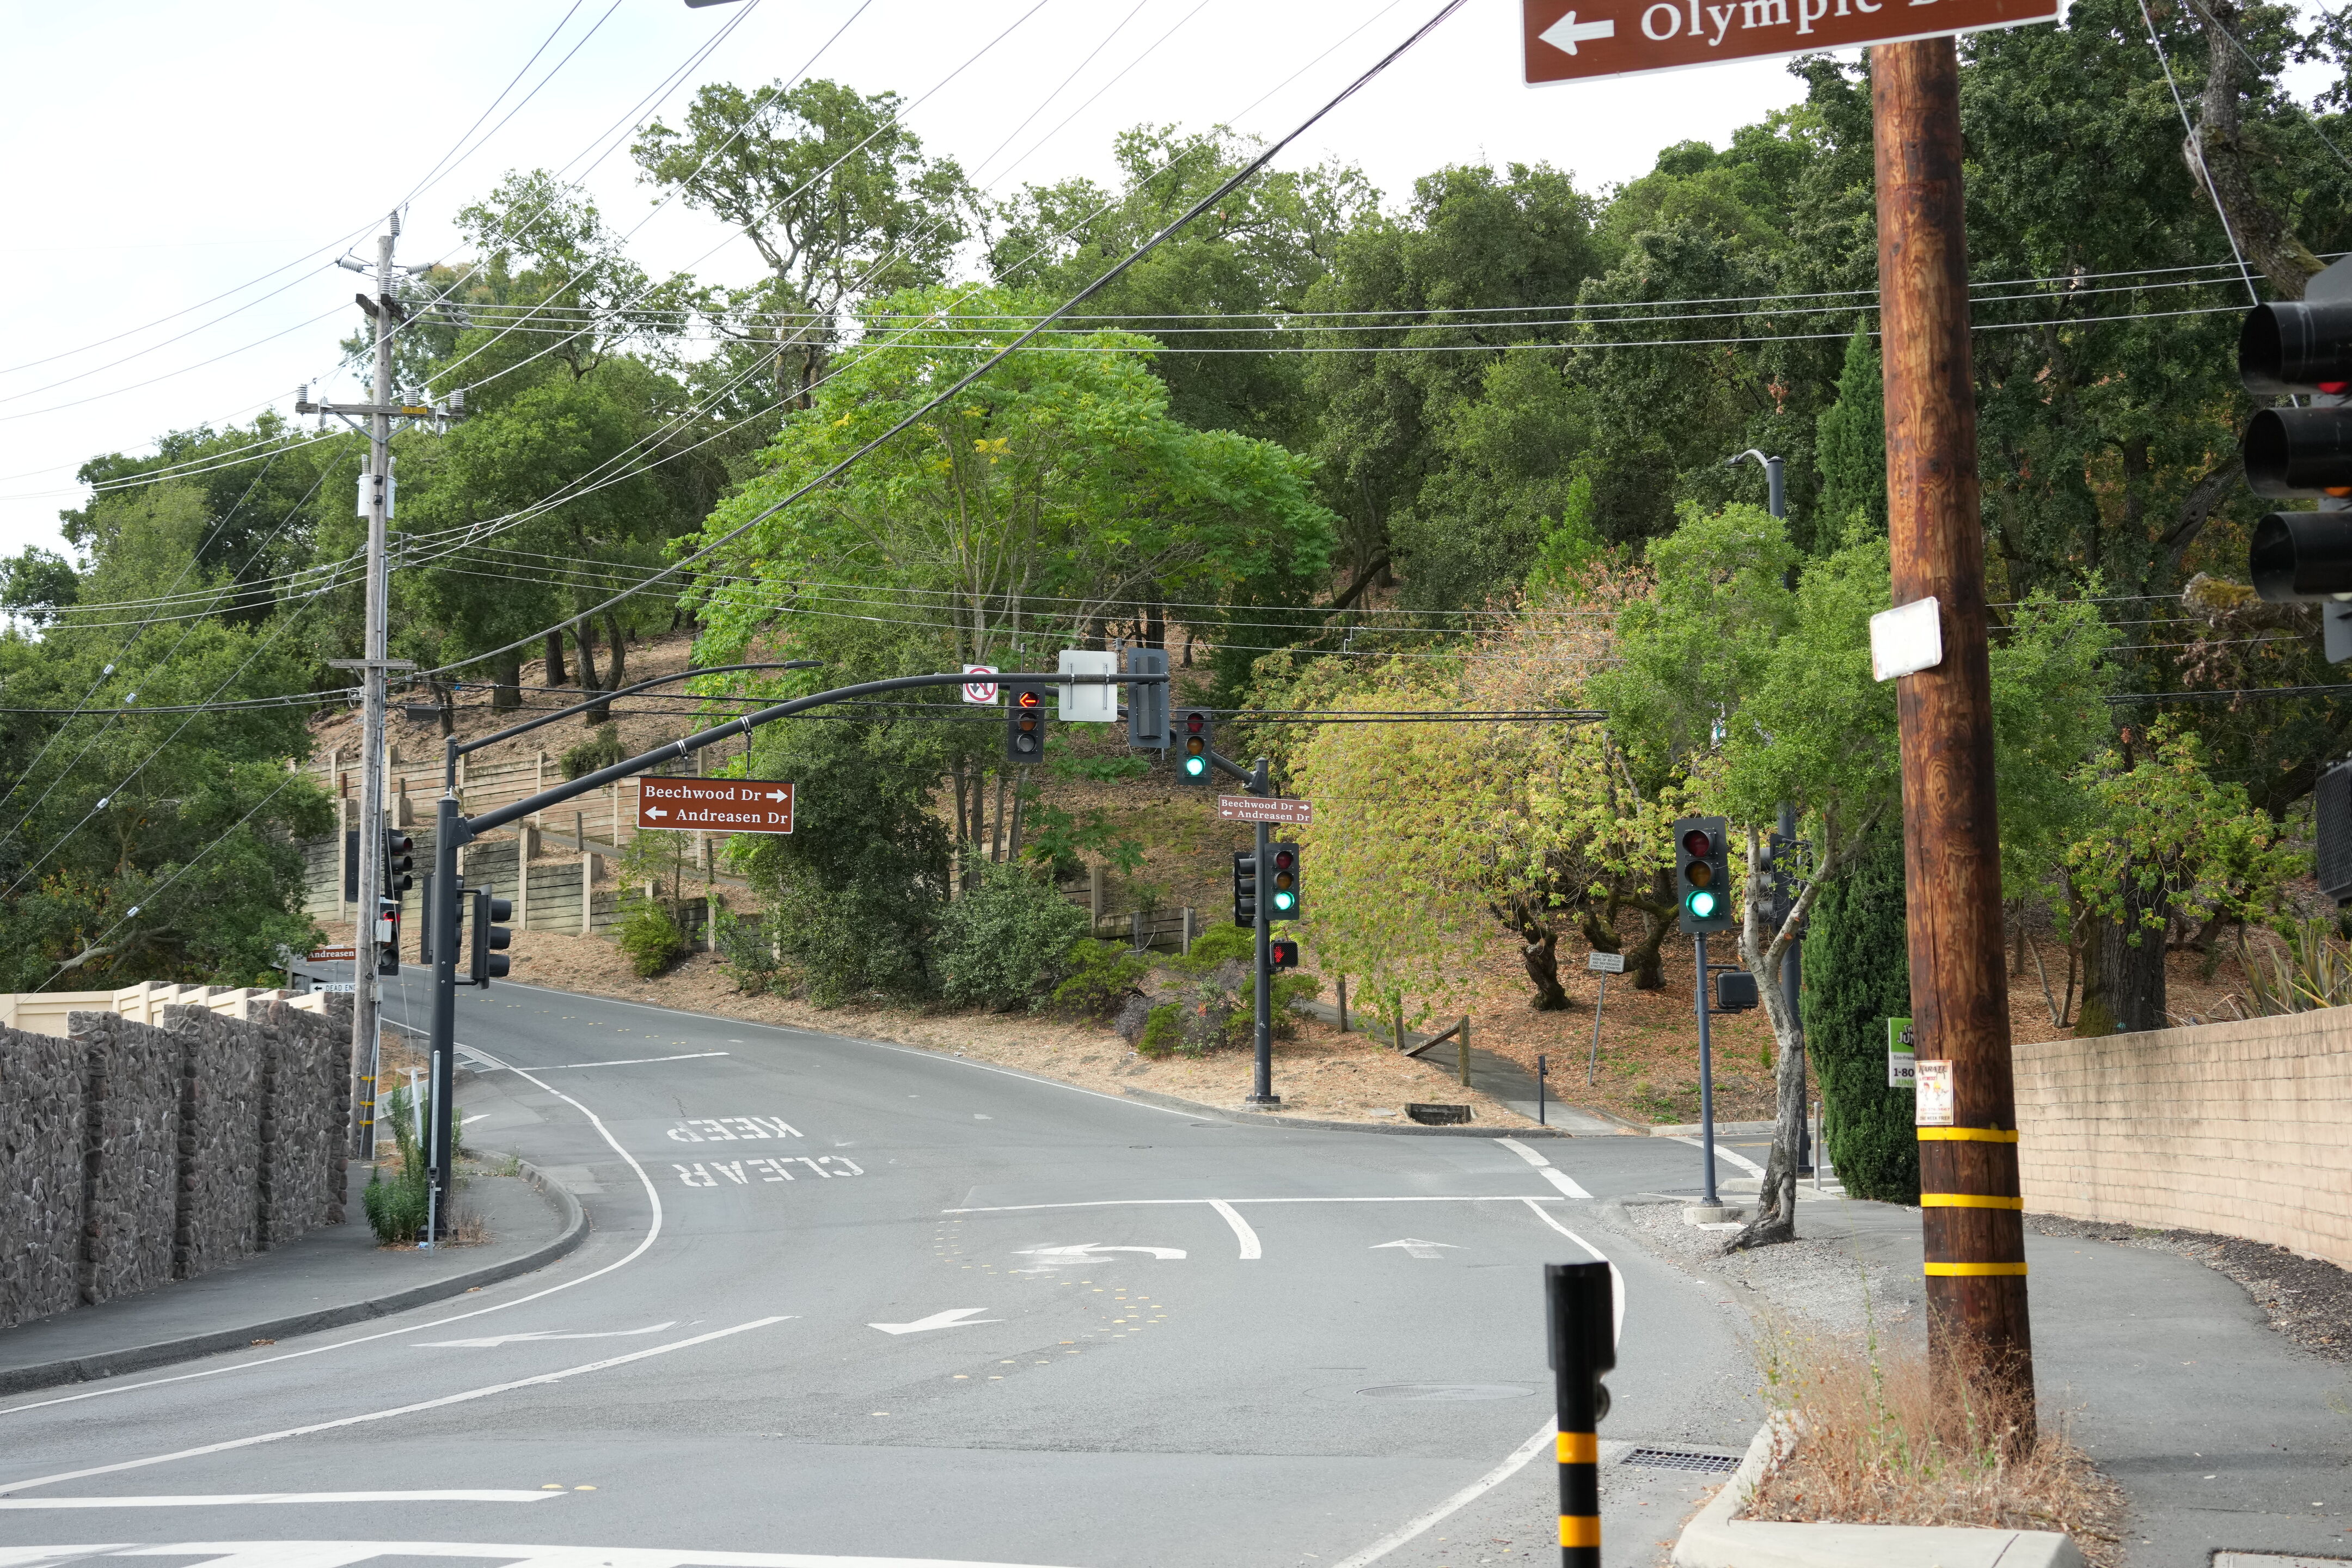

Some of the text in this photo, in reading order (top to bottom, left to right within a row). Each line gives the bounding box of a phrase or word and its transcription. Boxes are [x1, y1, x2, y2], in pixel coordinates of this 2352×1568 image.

[645, 786, 762, 801] Beechwood Dr
[1221, 799, 1277, 810] Beechwood
[676, 808, 788, 824] Andreasen Dr
[1238, 810, 1293, 820] Andreasen
[1919, 1065, 1947, 1075] KARATE
[667, 1117, 805, 1142] KEEP
[671, 1155, 865, 1187] CLEAR
